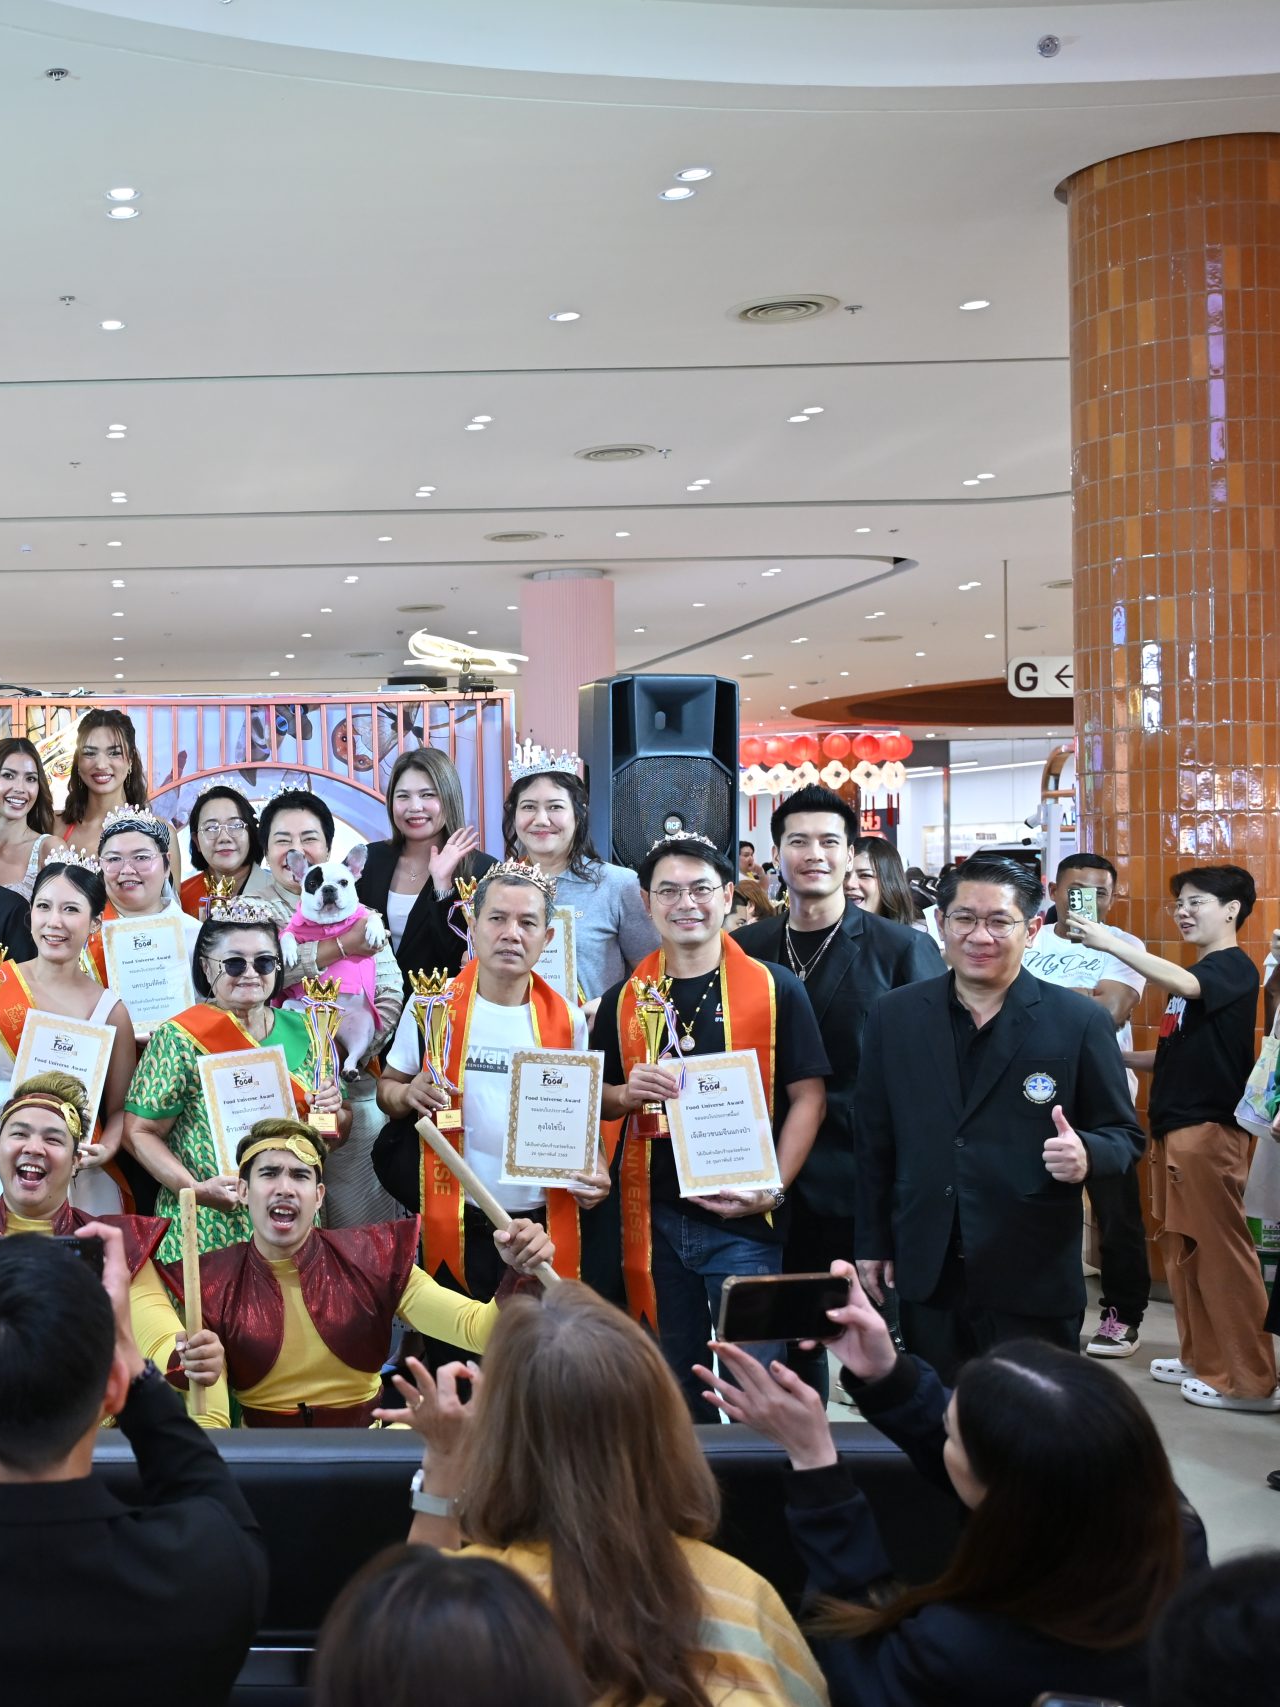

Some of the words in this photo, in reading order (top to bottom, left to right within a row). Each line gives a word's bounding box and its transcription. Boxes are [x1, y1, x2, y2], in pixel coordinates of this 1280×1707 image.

[1014, 662, 1039, 692] G
[666, 821, 680, 830] RCF
[134, 938, 152, 949] Food
[1025, 951, 1059, 975] My
[1060, 953, 1100, 973] Deli
[53, 1040, 73, 1052] Food
[234, 1076, 253, 1086] Food
[542, 1074, 563, 1084] Food
[698, 1081, 720, 1092] Food
[626, 1138, 643, 1245] NIVERSE
